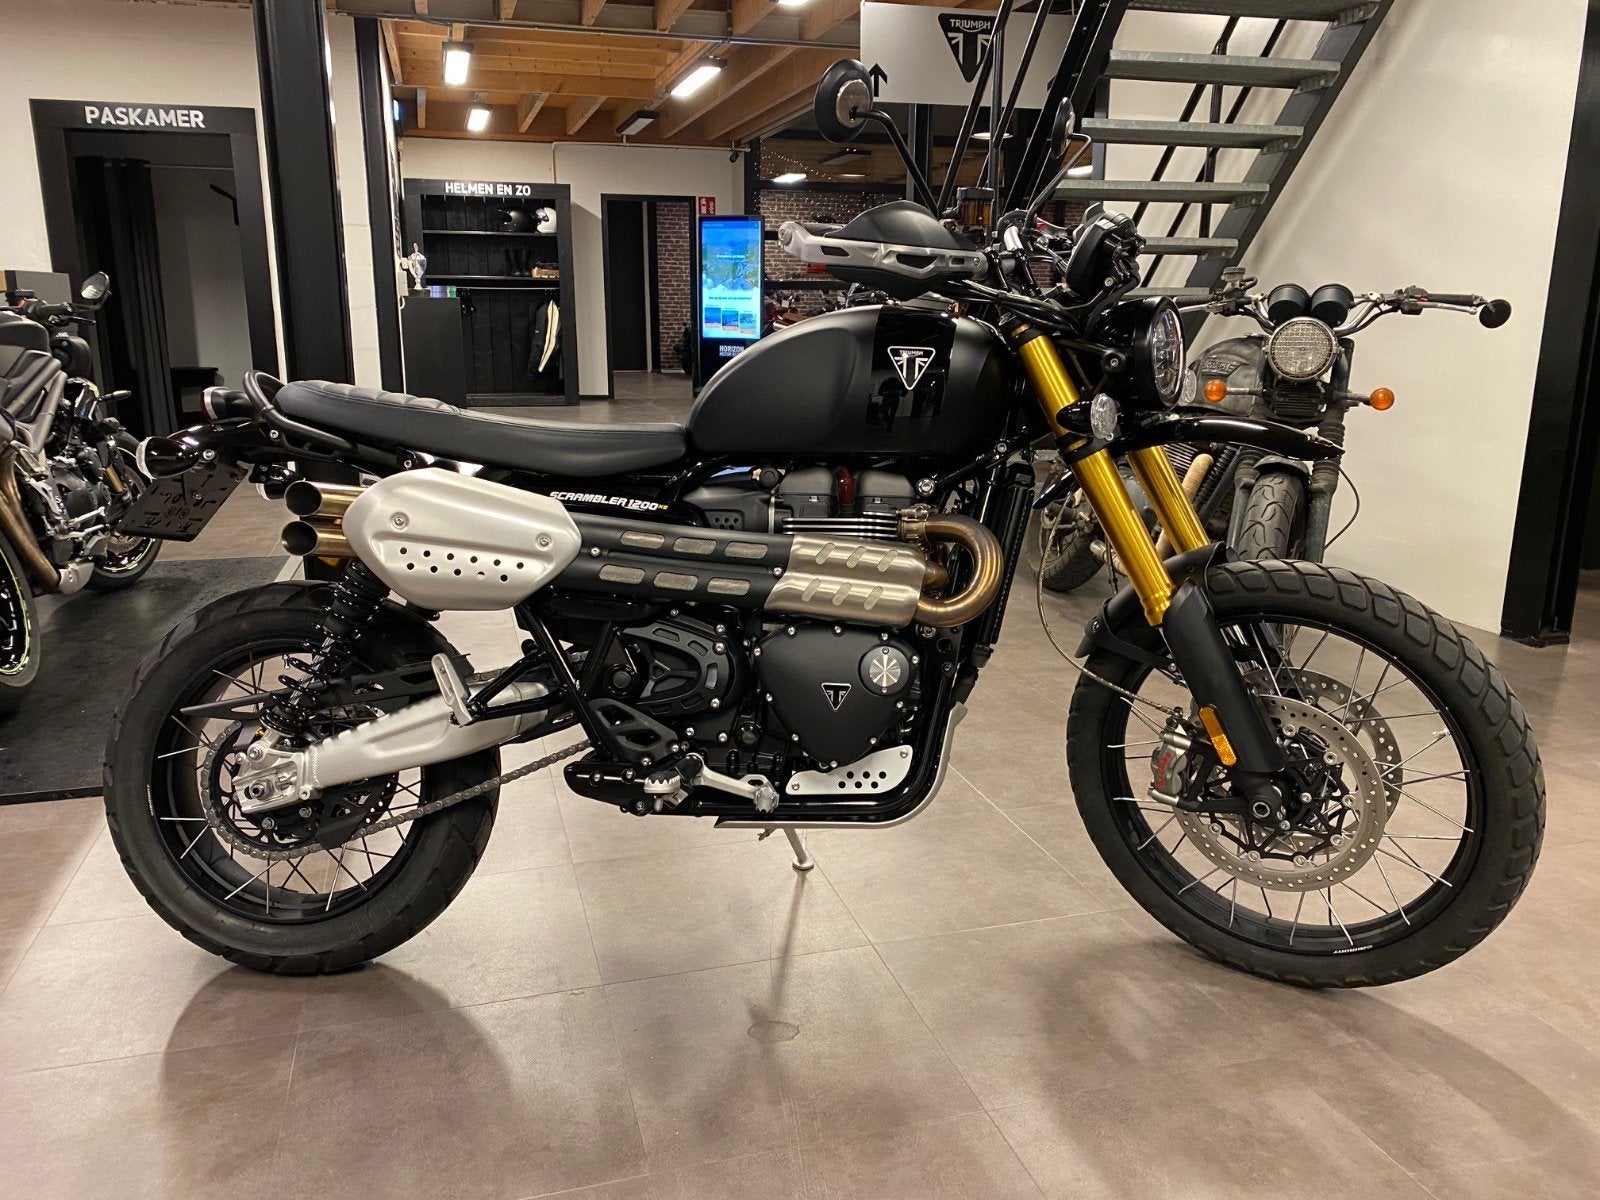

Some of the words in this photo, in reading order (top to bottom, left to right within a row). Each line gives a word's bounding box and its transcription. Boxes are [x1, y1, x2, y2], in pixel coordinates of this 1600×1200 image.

[949, 18, 991, 30] TRIUMPH
[84, 105, 206, 128] PASKAMER
[444, 181, 494, 195] HELMEN
[496, 183, 513, 196] EN
[515, 184, 532, 197] ZO
[549, 491, 628, 507] SCRAMBLER
[625, 498, 660, 511] 1200
